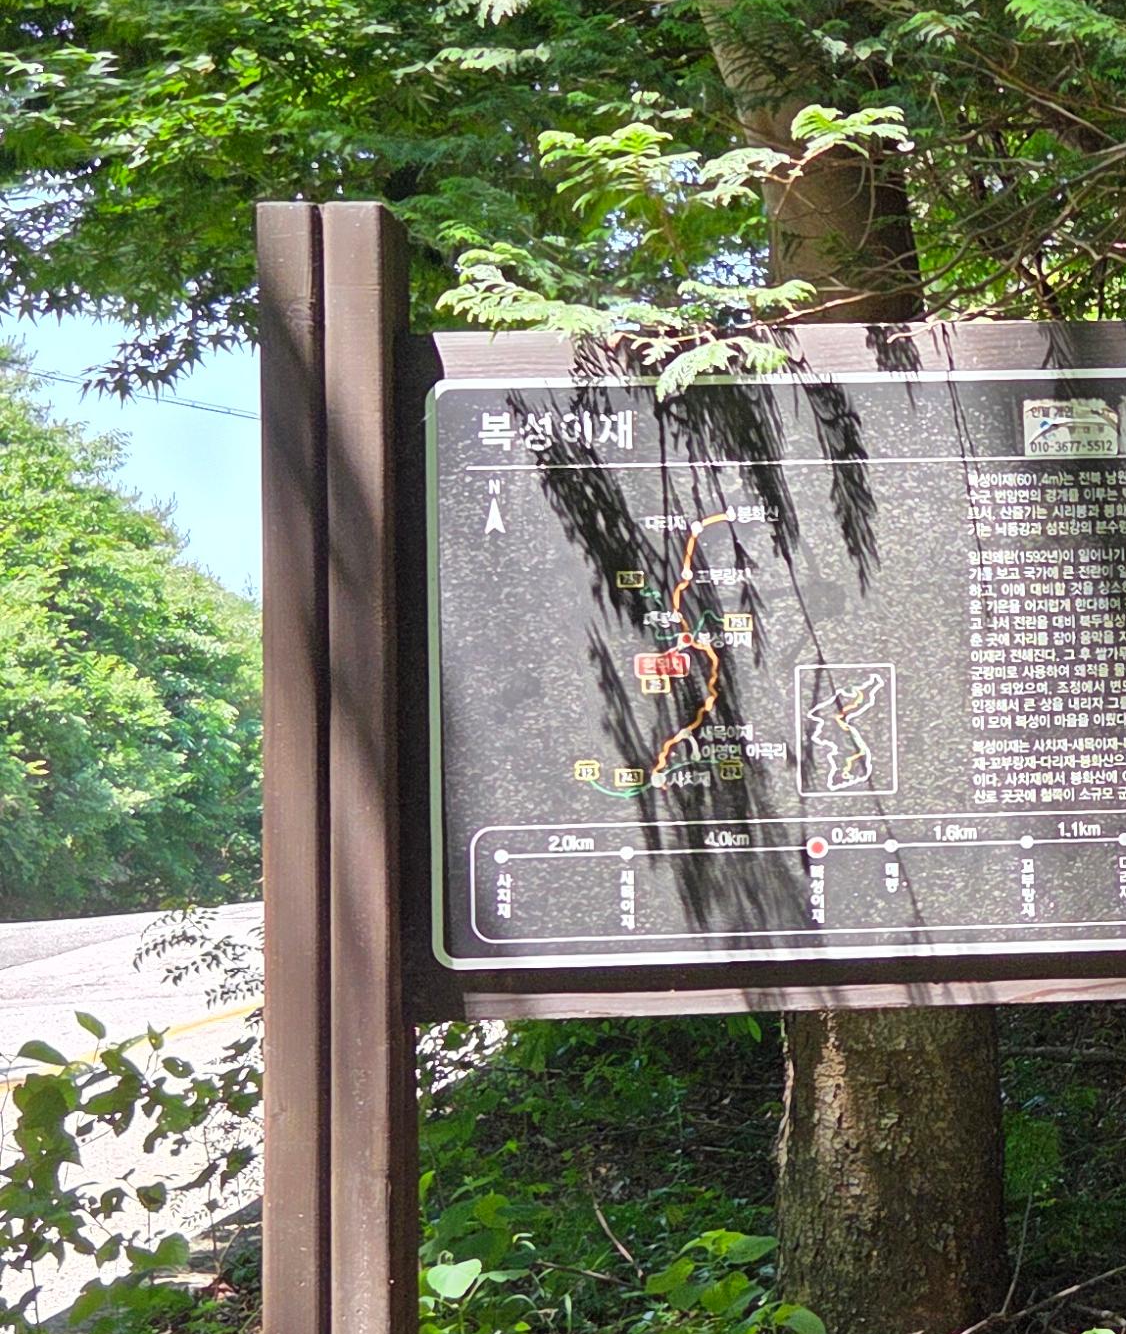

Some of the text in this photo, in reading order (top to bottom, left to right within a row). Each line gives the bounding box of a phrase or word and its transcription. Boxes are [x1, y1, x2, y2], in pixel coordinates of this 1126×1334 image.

[478, 410, 633, 451] 복성이재
[1030, 440, 1113, 452] 010-3677-5512
[488, 479, 500, 494] N
[968, 617, 982, 629] 고
[1063, 648, 1075, 660] 그
[832, 827, 877, 844] 0.3km
[933, 824, 977, 842] 1.6km
[1057, 821, 1101, 837] 1.1km
[548, 835, 595, 852] 2.0km
[704, 831, 750, 847] 4.0km
